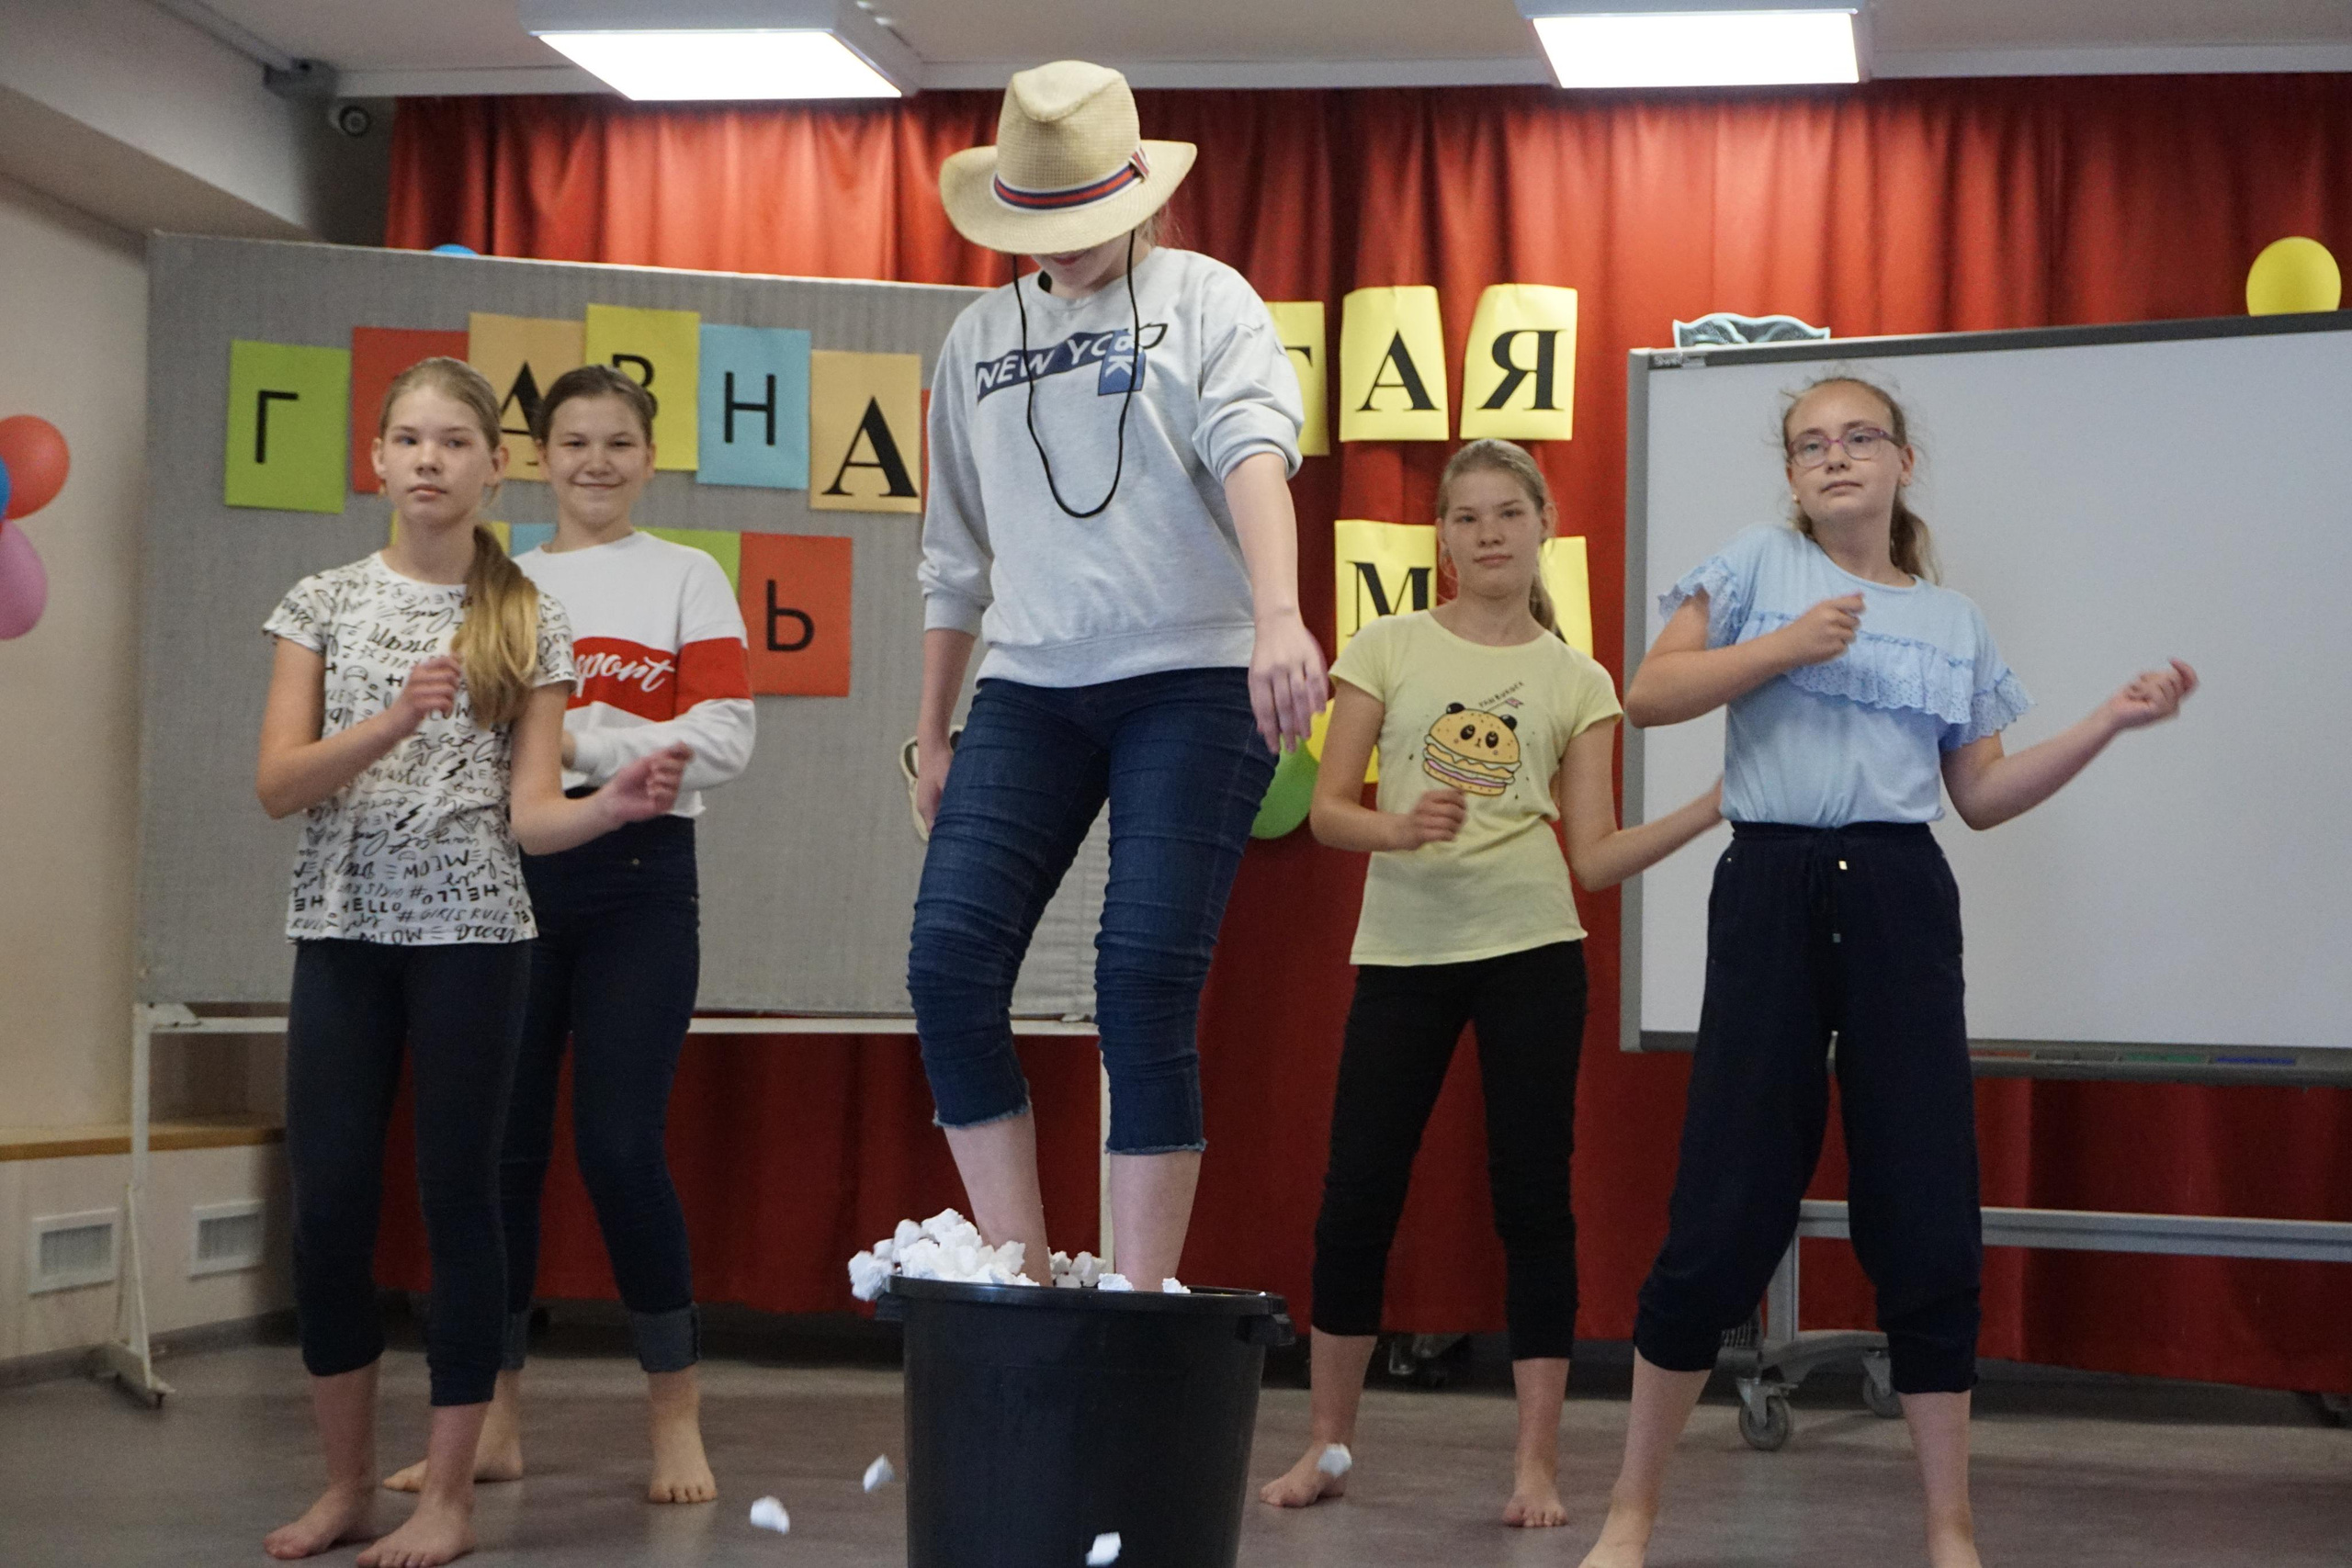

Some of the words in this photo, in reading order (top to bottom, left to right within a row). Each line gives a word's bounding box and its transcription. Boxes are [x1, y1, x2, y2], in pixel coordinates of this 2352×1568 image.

[976, 350, 1056, 396] NEW
[575, 652, 675, 698] port
[422, 885, 500, 905] HELLO
